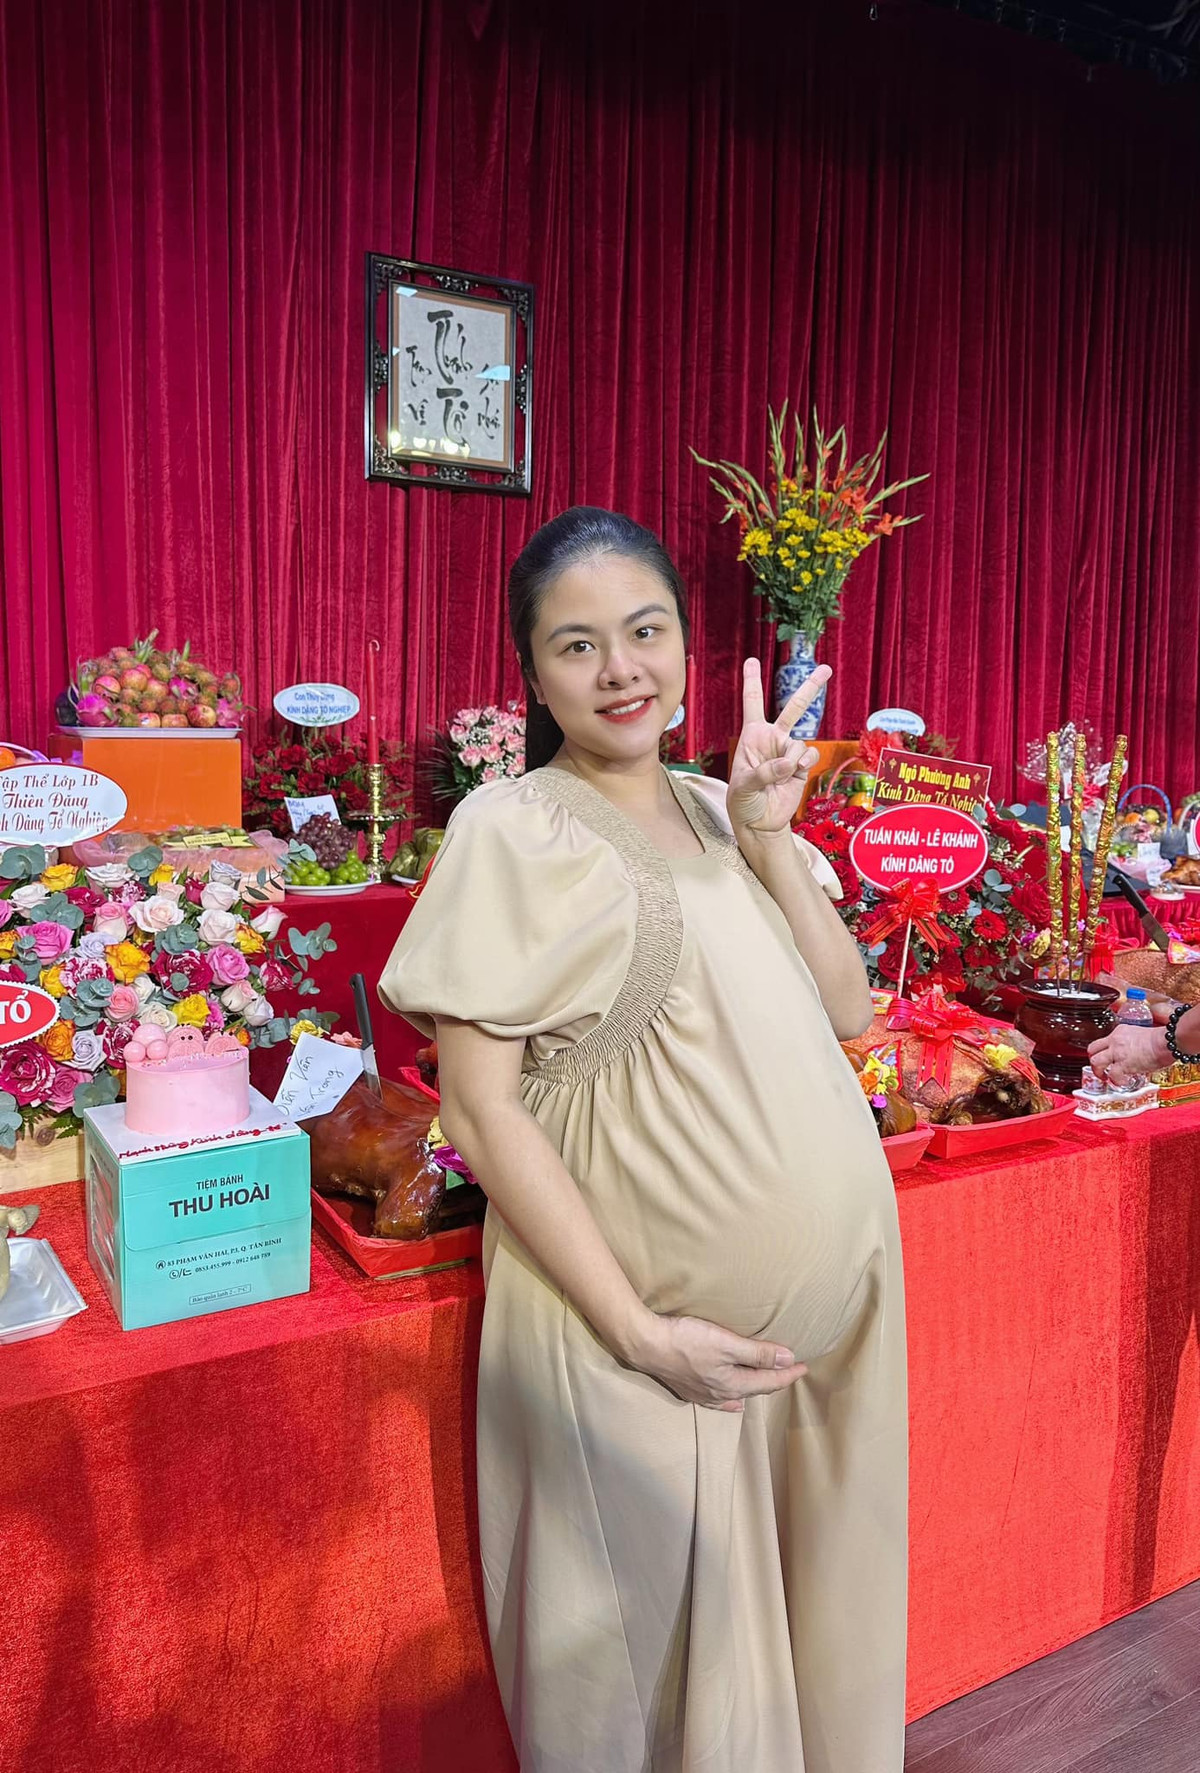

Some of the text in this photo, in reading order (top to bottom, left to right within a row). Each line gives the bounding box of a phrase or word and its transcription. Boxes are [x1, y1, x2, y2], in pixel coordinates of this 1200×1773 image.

[0, 776, 18, 792] ập
[24, 773, 49, 789] Thể
[82, 774, 99, 787] 1B
[899, 763, 971, 791] Ngô Phương Anh
[3, 792, 44, 809] Thiên
[926, 828, 941, 847] LÊ
[941, 829, 979, 849] KHÁNH
[881, 853, 906, 873] KÍNH
[908, 854, 939, 874] DÂNG
[196, 1173, 244, 1192] TIỆM BÁNH
[168, 1181, 270, 1218] THU HOÀI
